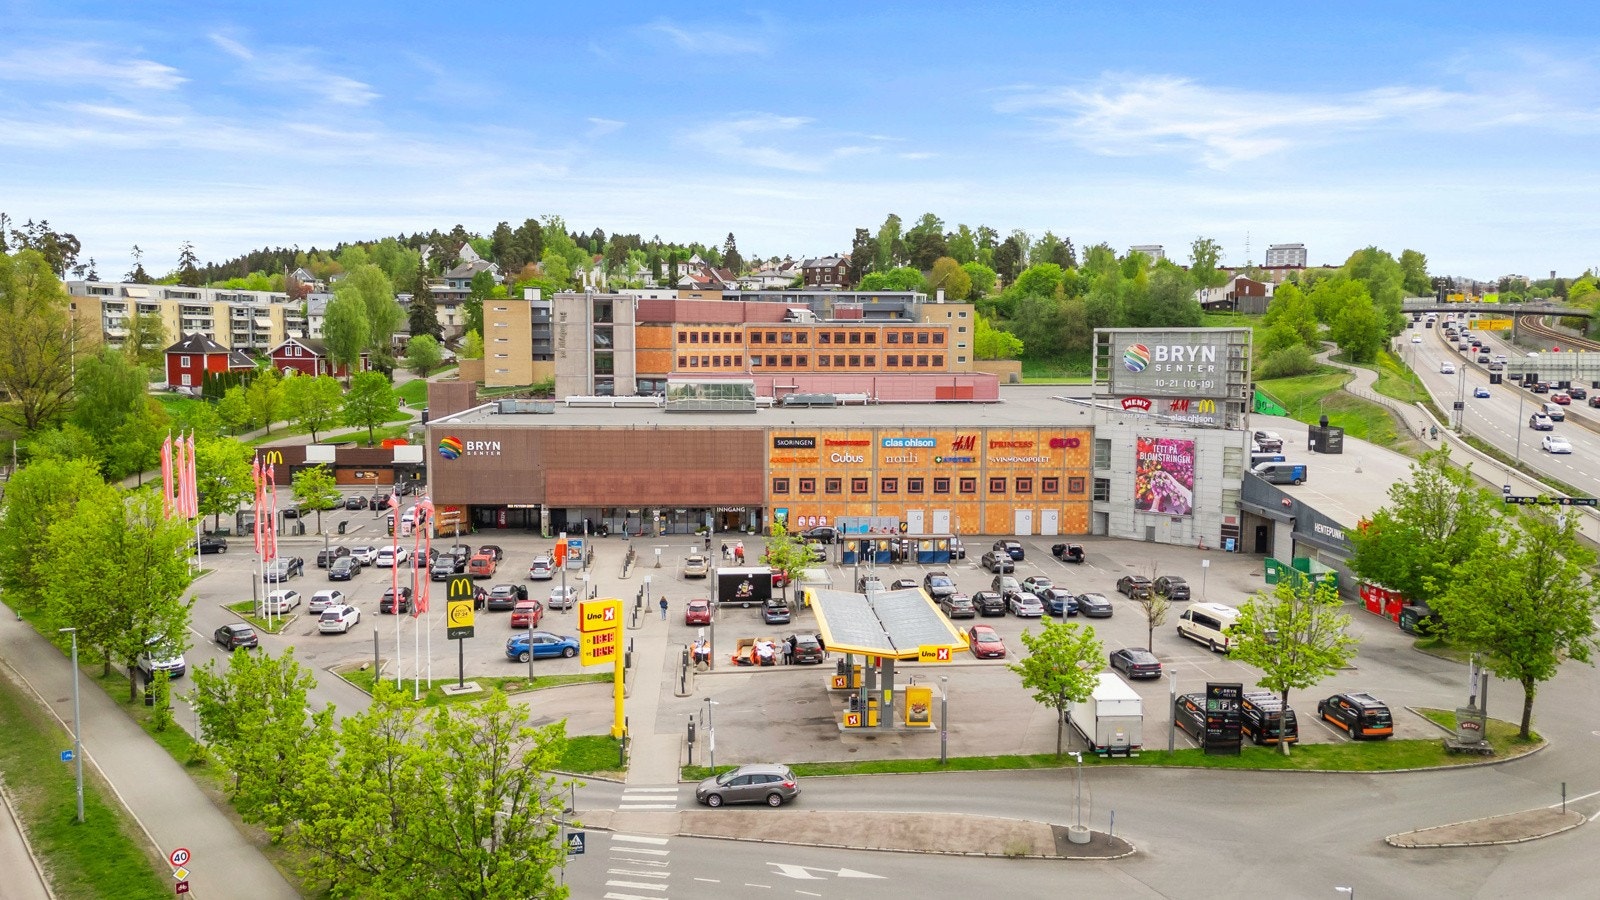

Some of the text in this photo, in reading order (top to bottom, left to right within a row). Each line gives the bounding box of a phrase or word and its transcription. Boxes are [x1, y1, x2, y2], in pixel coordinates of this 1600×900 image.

[1155, 345, 1216, 362] BRYN
[1155, 364, 1215, 373] SENTER
[1155, 379, 1214, 388] 10-21 (10-19)
[1124, 399, 1149, 407] MENY
[466, 441, 501, 450] BRYN
[885, 438, 934, 447] clas ohlson
[952, 435, 976, 451] H&M
[993, 440, 1033, 448] PRINCESS
[1153, 444, 1178, 455] TETT PÅ
[831, 452, 864, 463] Cubus
[885, 451, 919, 463] norli
[1139, 452, 1191, 464] BLOMSTRINGEN
[604, 608, 614, 620] X
[938, 649, 949, 660] X
[173, 851, 187, 862] 40
